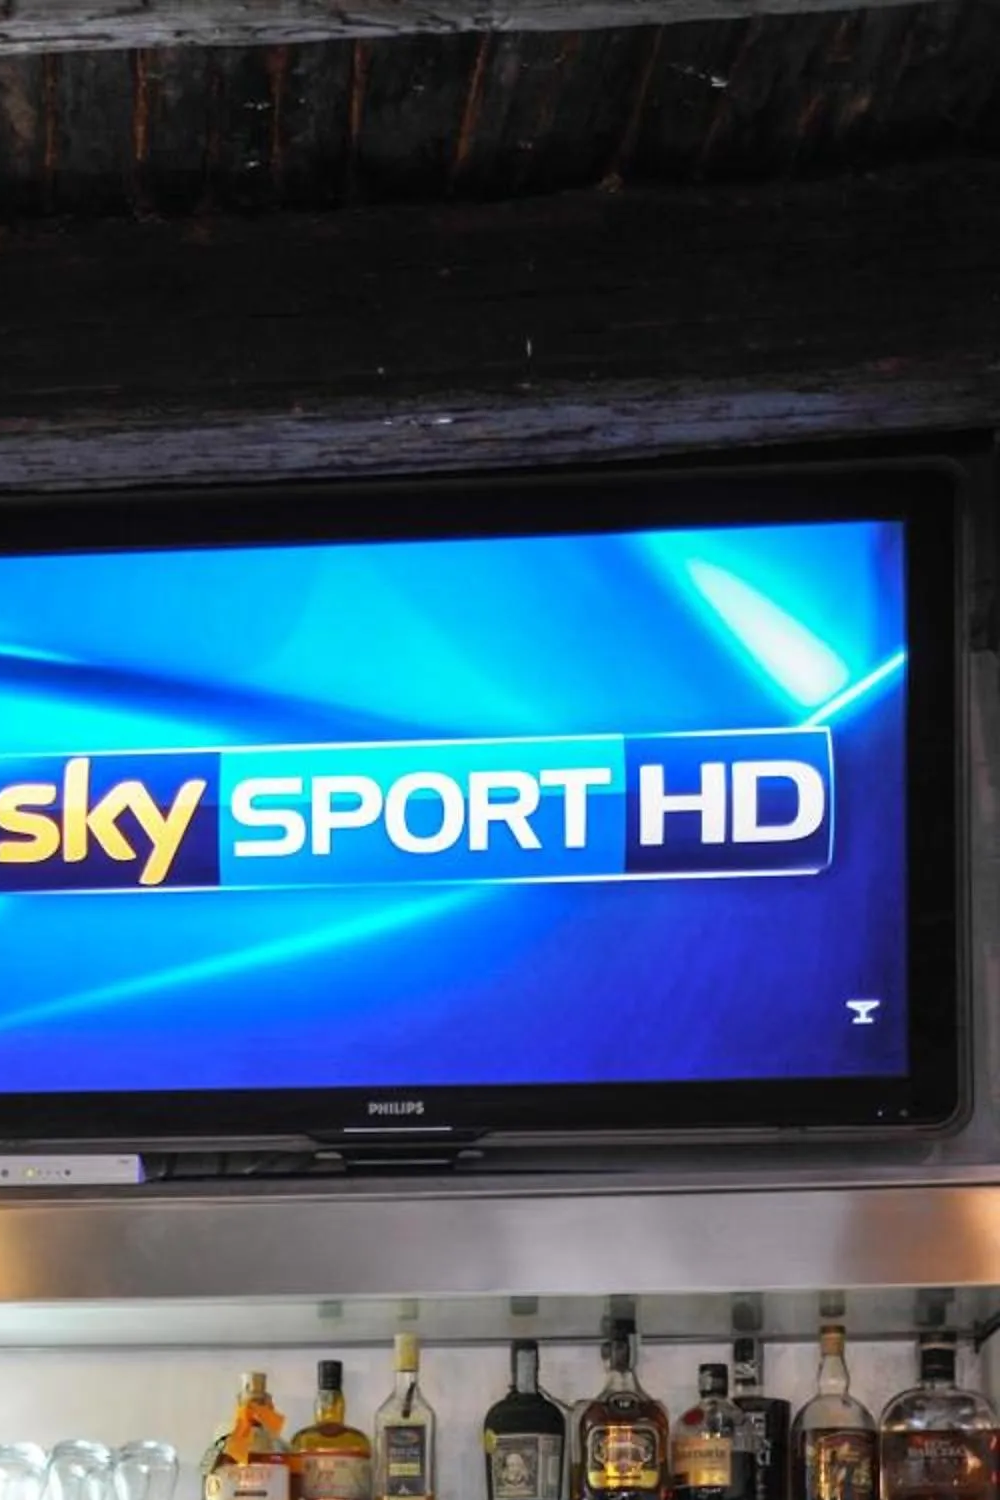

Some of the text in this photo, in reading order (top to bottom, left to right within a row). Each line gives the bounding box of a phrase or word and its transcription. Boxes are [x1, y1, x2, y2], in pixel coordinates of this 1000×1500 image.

[231, 767, 611, 857] SPORT
[638, 760, 826, 845] HD
[368, 1102, 424, 1115] PHILIPS
